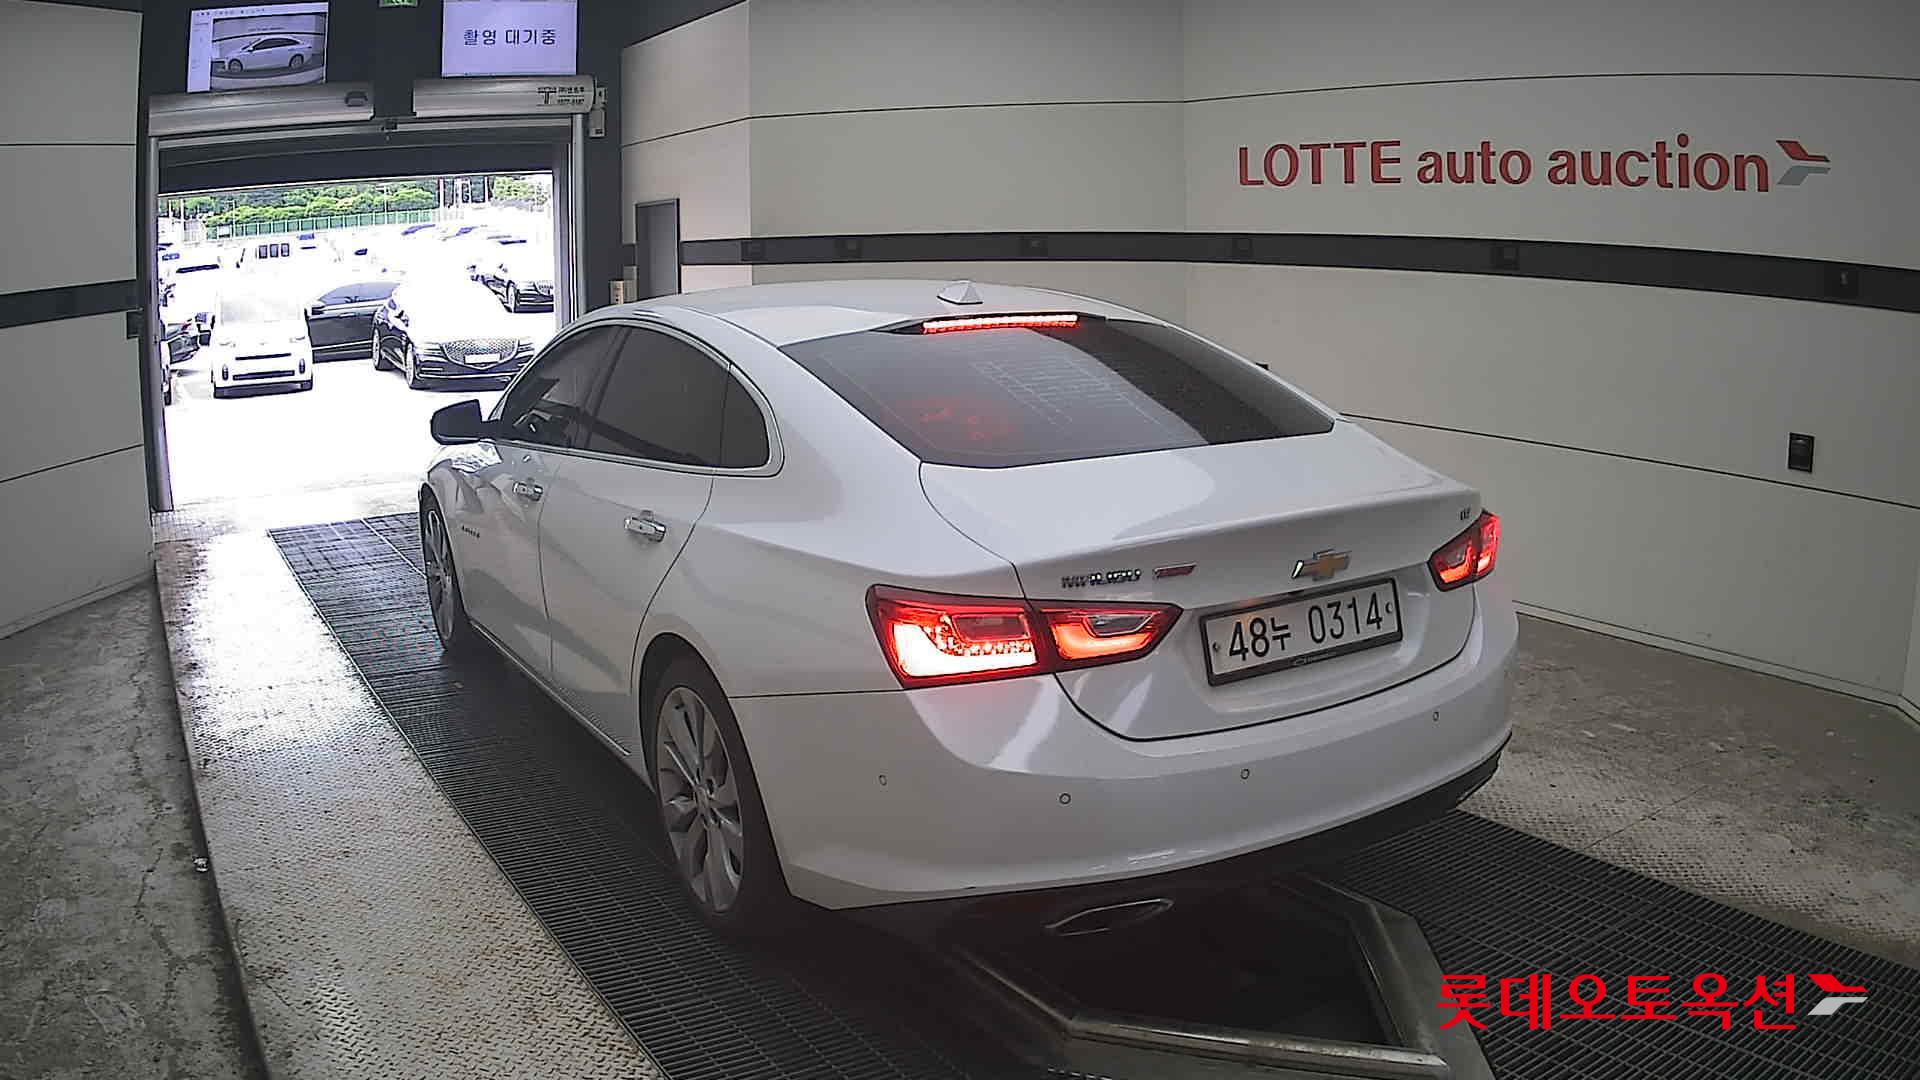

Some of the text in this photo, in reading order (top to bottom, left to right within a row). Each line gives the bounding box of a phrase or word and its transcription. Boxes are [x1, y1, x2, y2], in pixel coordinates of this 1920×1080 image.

[464, 29, 556, 46] 촬영 대기중
[1239, 133, 1769, 193] LOTTE auto auction
[1228, 592, 1383, 661] 48누 0314
